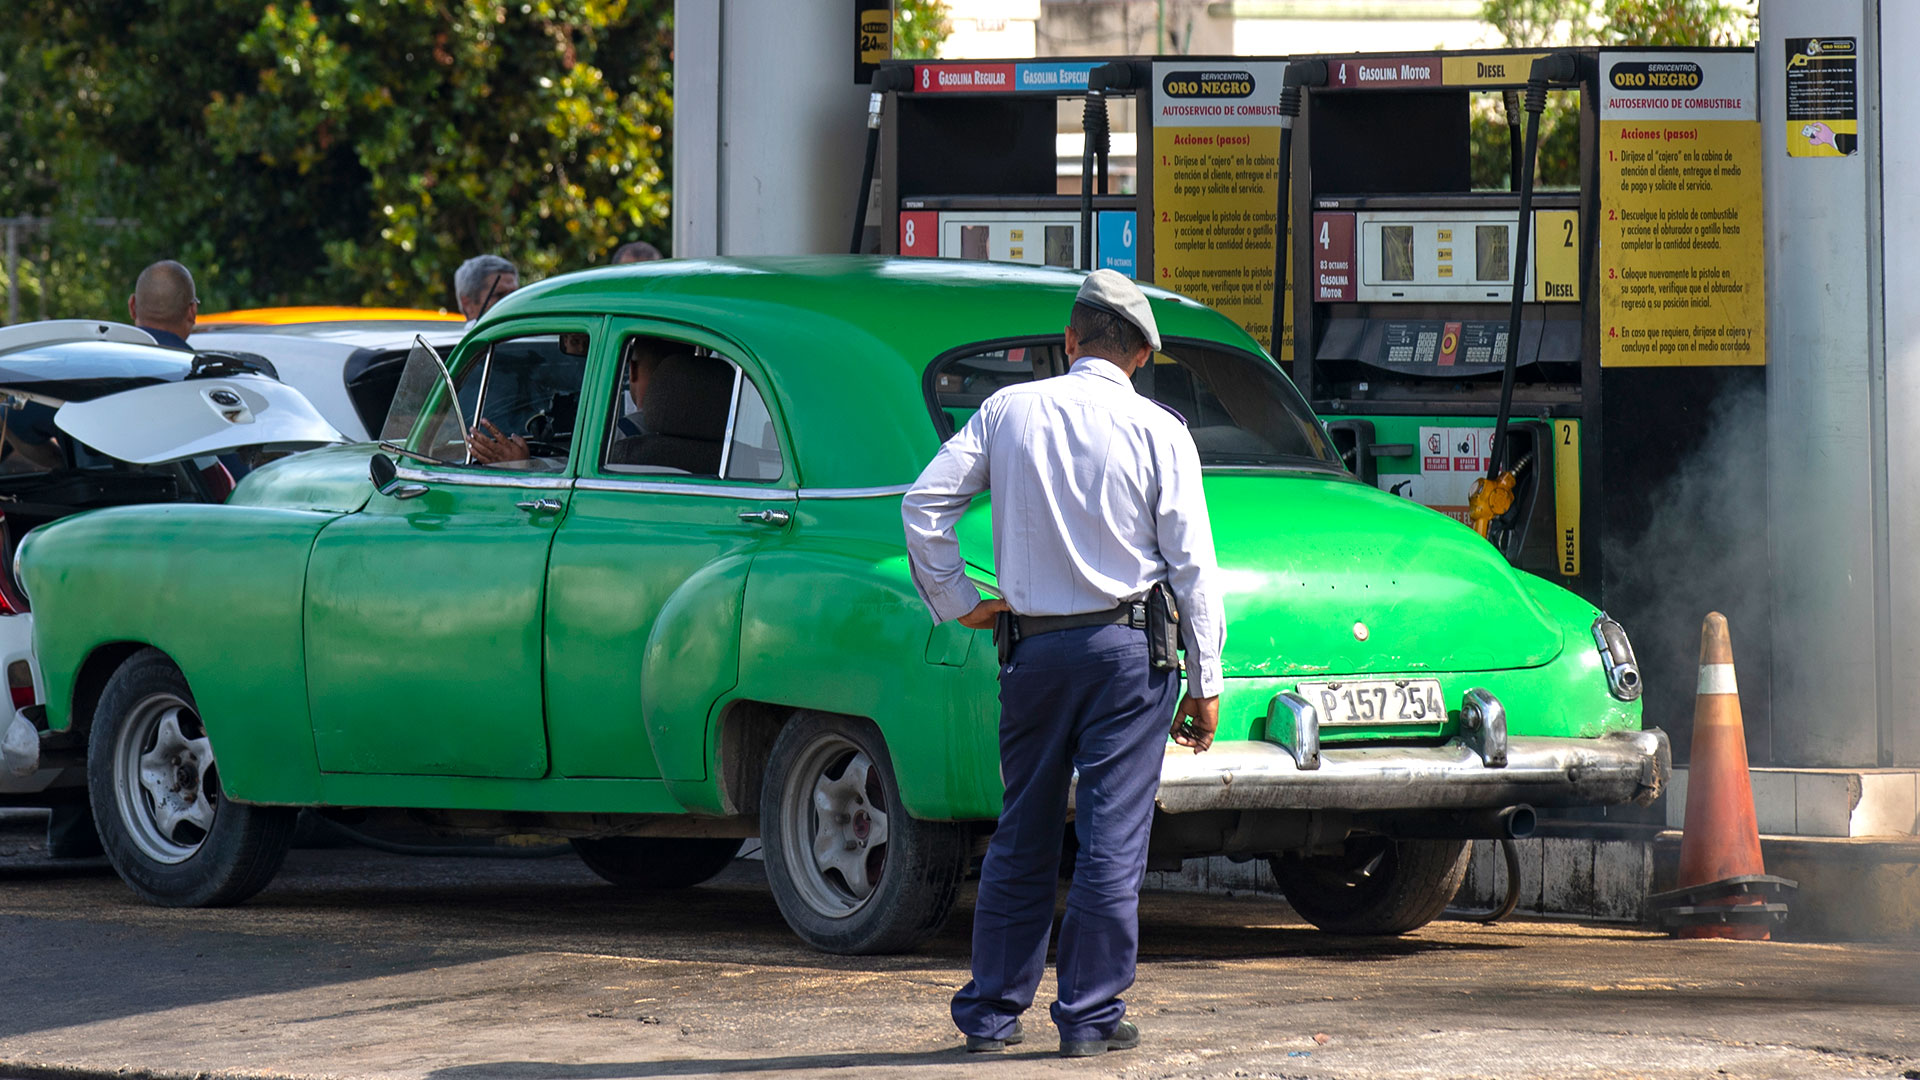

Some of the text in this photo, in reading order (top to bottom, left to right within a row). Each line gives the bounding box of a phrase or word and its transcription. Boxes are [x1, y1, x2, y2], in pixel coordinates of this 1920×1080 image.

[1023, 70, 1090, 84] GASOLINA ESPECIA
[1338, 64, 1430, 84] 4 GASOLINA MOTOR
[1477, 63, 1506, 78] DIESEL
[922, 68, 1006, 88] 8 GASOLINA REGULAR
[1615, 73, 1699, 86] ORO NEGRO
[1168, 82, 1250, 94] ORO NEGRO
[1609, 98, 1741, 108] AUTOSERVICIO DE COMBUSTIBLE
[1163, 106, 1221, 115] AUTOSERVICIO
[1224, 106, 1234, 115] DE
[1174, 134, 1250, 147] Acciones (pasos)
[1621, 128, 1698, 142] Acciones (pasos)
[1254, 155, 1274, 166] cabina
[1609, 151, 1617, 161] 1.
[1648, 149, 1653, 161] al
[1694, 149, 1699, 161] la
[1702, 150, 1722, 161] cabina
[1724, 149, 1732, 161] de
[1236, 169, 1264, 182] entregue
[1621, 164, 1741, 178] atención al cliente, entregue el medio
[1174, 182, 1182, 193] de
[1184, 186, 1200, 197] pago
[1208, 182, 1229, 193] solicite
[1621, 179, 1712, 193] de pago y solicite el servicio.
[1162, 210, 1250, 224] 2. Descuelgue pistola de
[1609, 208, 1738, 222] 2. Descuelgue la pistola de combustible
[906, 219, 915, 247] 8
[1123, 220, 1132, 247] 6
[1181, 226, 1204, 236] accione
[1213, 225, 1244, 236] obturador
[1253, 224, 1273, 238] gatillo
[1320, 221, 1330, 250] 4
[1564, 220, 1573, 247] 2
[1621, 223, 1740, 237] y accione el obturador o gatillo hasta
[1174, 240, 1272, 253] completar cantidad deseada.
[1621, 238, 1721, 251] completar la cantidad deseada.
[1107, 257, 1113, 267] 94
[1320, 260, 1348, 270] 83 OCTANOS
[1162, 266, 1272, 280] 3. Coloque nuevamente pistola
[1320, 274, 1348, 285] GASOLINA
[1609, 266, 1730, 281] 3. Coloque nuevamente la pistola en
[1212, 280, 1253, 294] verifique que
[1321, 287, 1342, 298] MOTOR
[1545, 281, 1574, 297] DIESEL
[1621, 281, 1743, 296] su soporte, verifique que el obturador
[1622, 296, 1712, 311] regresó a su posición inicial.
[1609, 327, 1618, 338] 4.
[1622, 326, 1629, 337] En
[1632, 330, 1645, 338] caso
[1648, 329, 1660, 341] que
[1662, 326, 1690, 340] requiera,
[1718, 325, 1724, 336] al
[1726, 326, 1745, 339] cajero
[1747, 328, 1751, 339] y
[1622, 340, 1649, 354] concluya
[1652, 340, 1658, 352] el
[1660, 343, 1675, 354] pago
[1691, 339, 1696, 351] el
[1699, 340, 1718, 351] medio
[1563, 425, 1571, 445] 2
[1565, 528, 1574, 573] DIESEL
[1321, 691, 1337, 721] P
[1342, 688, 1387, 720] 157
[1393, 688, 1442, 719] 254
